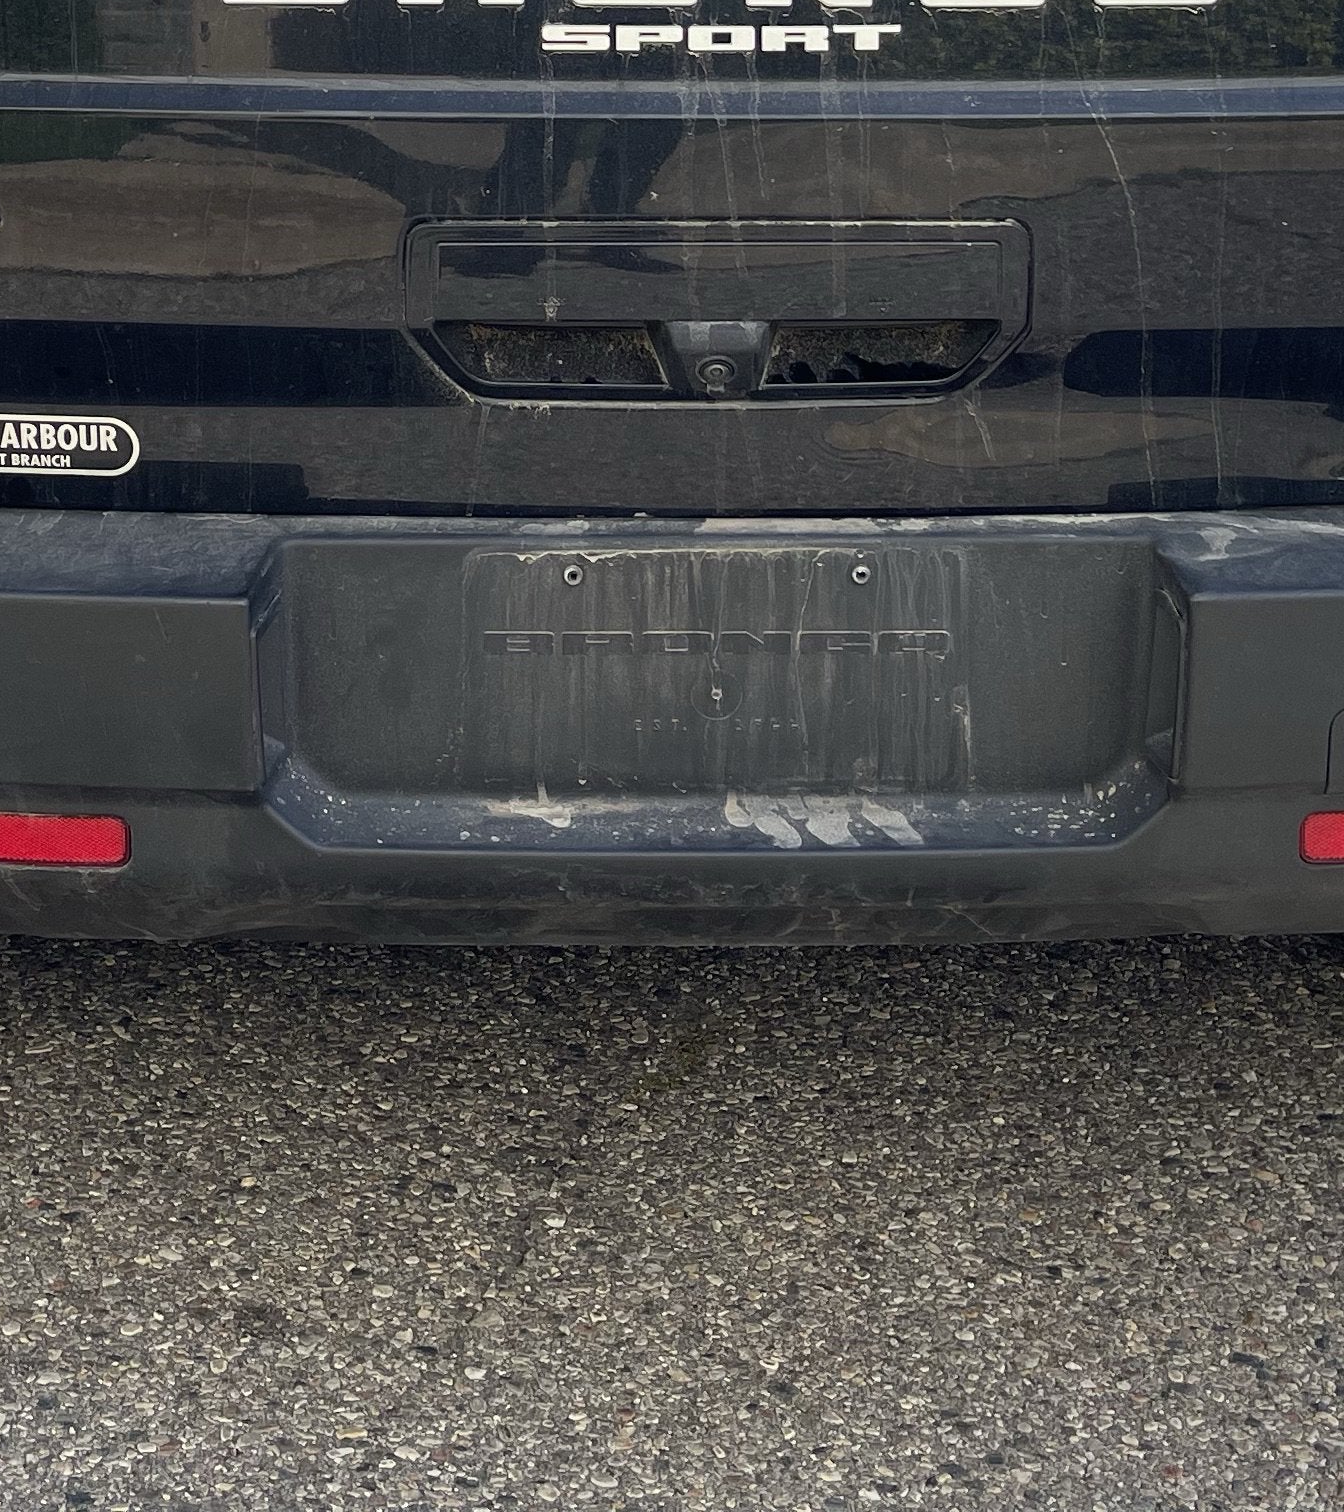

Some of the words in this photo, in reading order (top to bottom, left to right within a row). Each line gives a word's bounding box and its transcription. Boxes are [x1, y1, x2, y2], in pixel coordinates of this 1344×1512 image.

[541, 21, 902, 52] SPORT
[0, 422, 119, 452] ARBOUR
[11, 453, 72, 468] BRANCH
